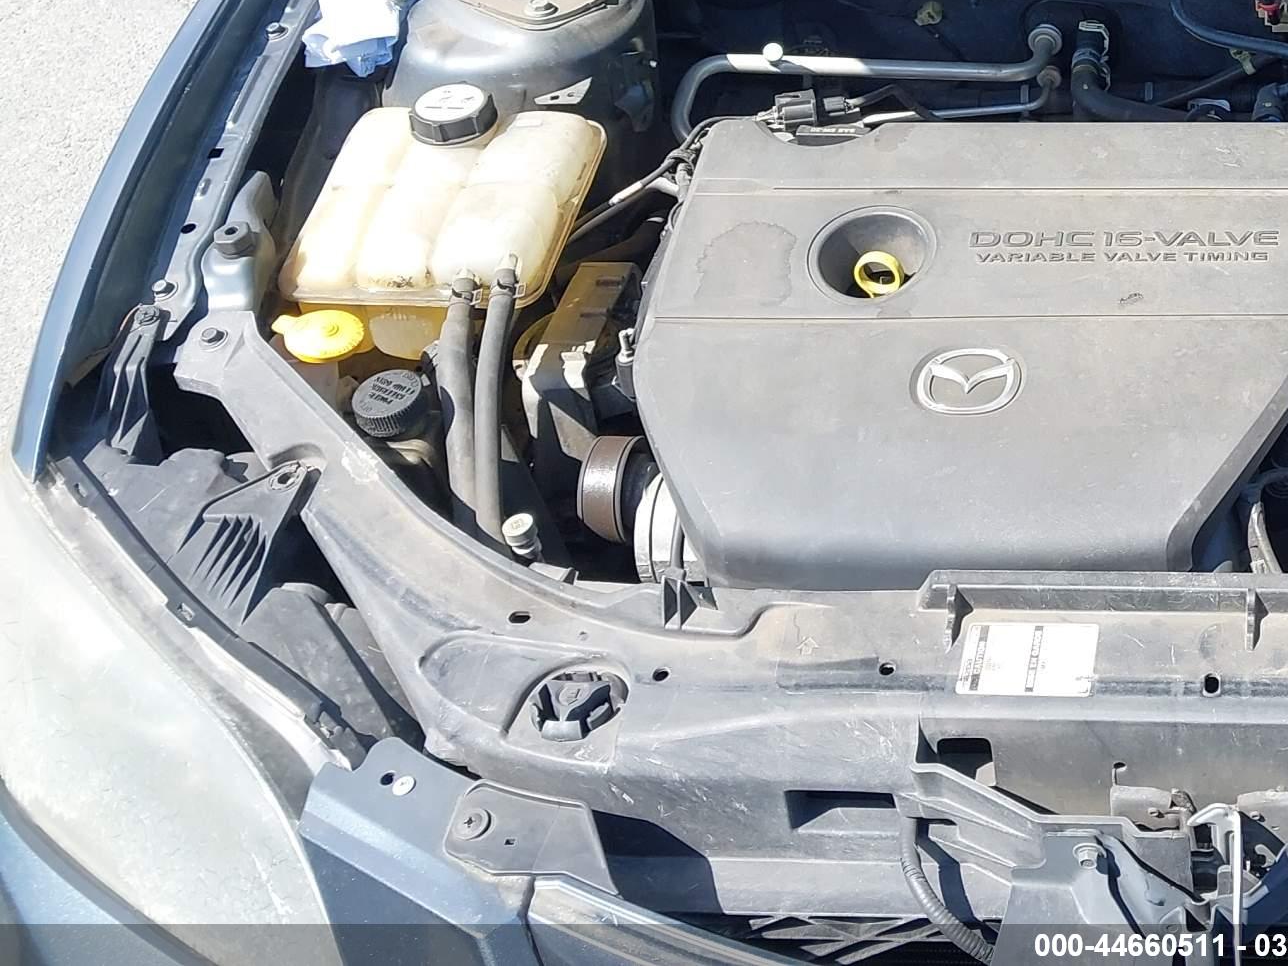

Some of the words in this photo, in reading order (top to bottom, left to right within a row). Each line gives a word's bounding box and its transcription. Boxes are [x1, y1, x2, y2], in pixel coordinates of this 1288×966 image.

[969, 231, 1095, 247] DOHC
[1103, 230, 1279, 247] 16-VALVE
[976, 252, 1096, 263] VARIABLE
[1103, 252, 1177, 262] VALVE
[1183, 251, 1269, 262] TIMING
